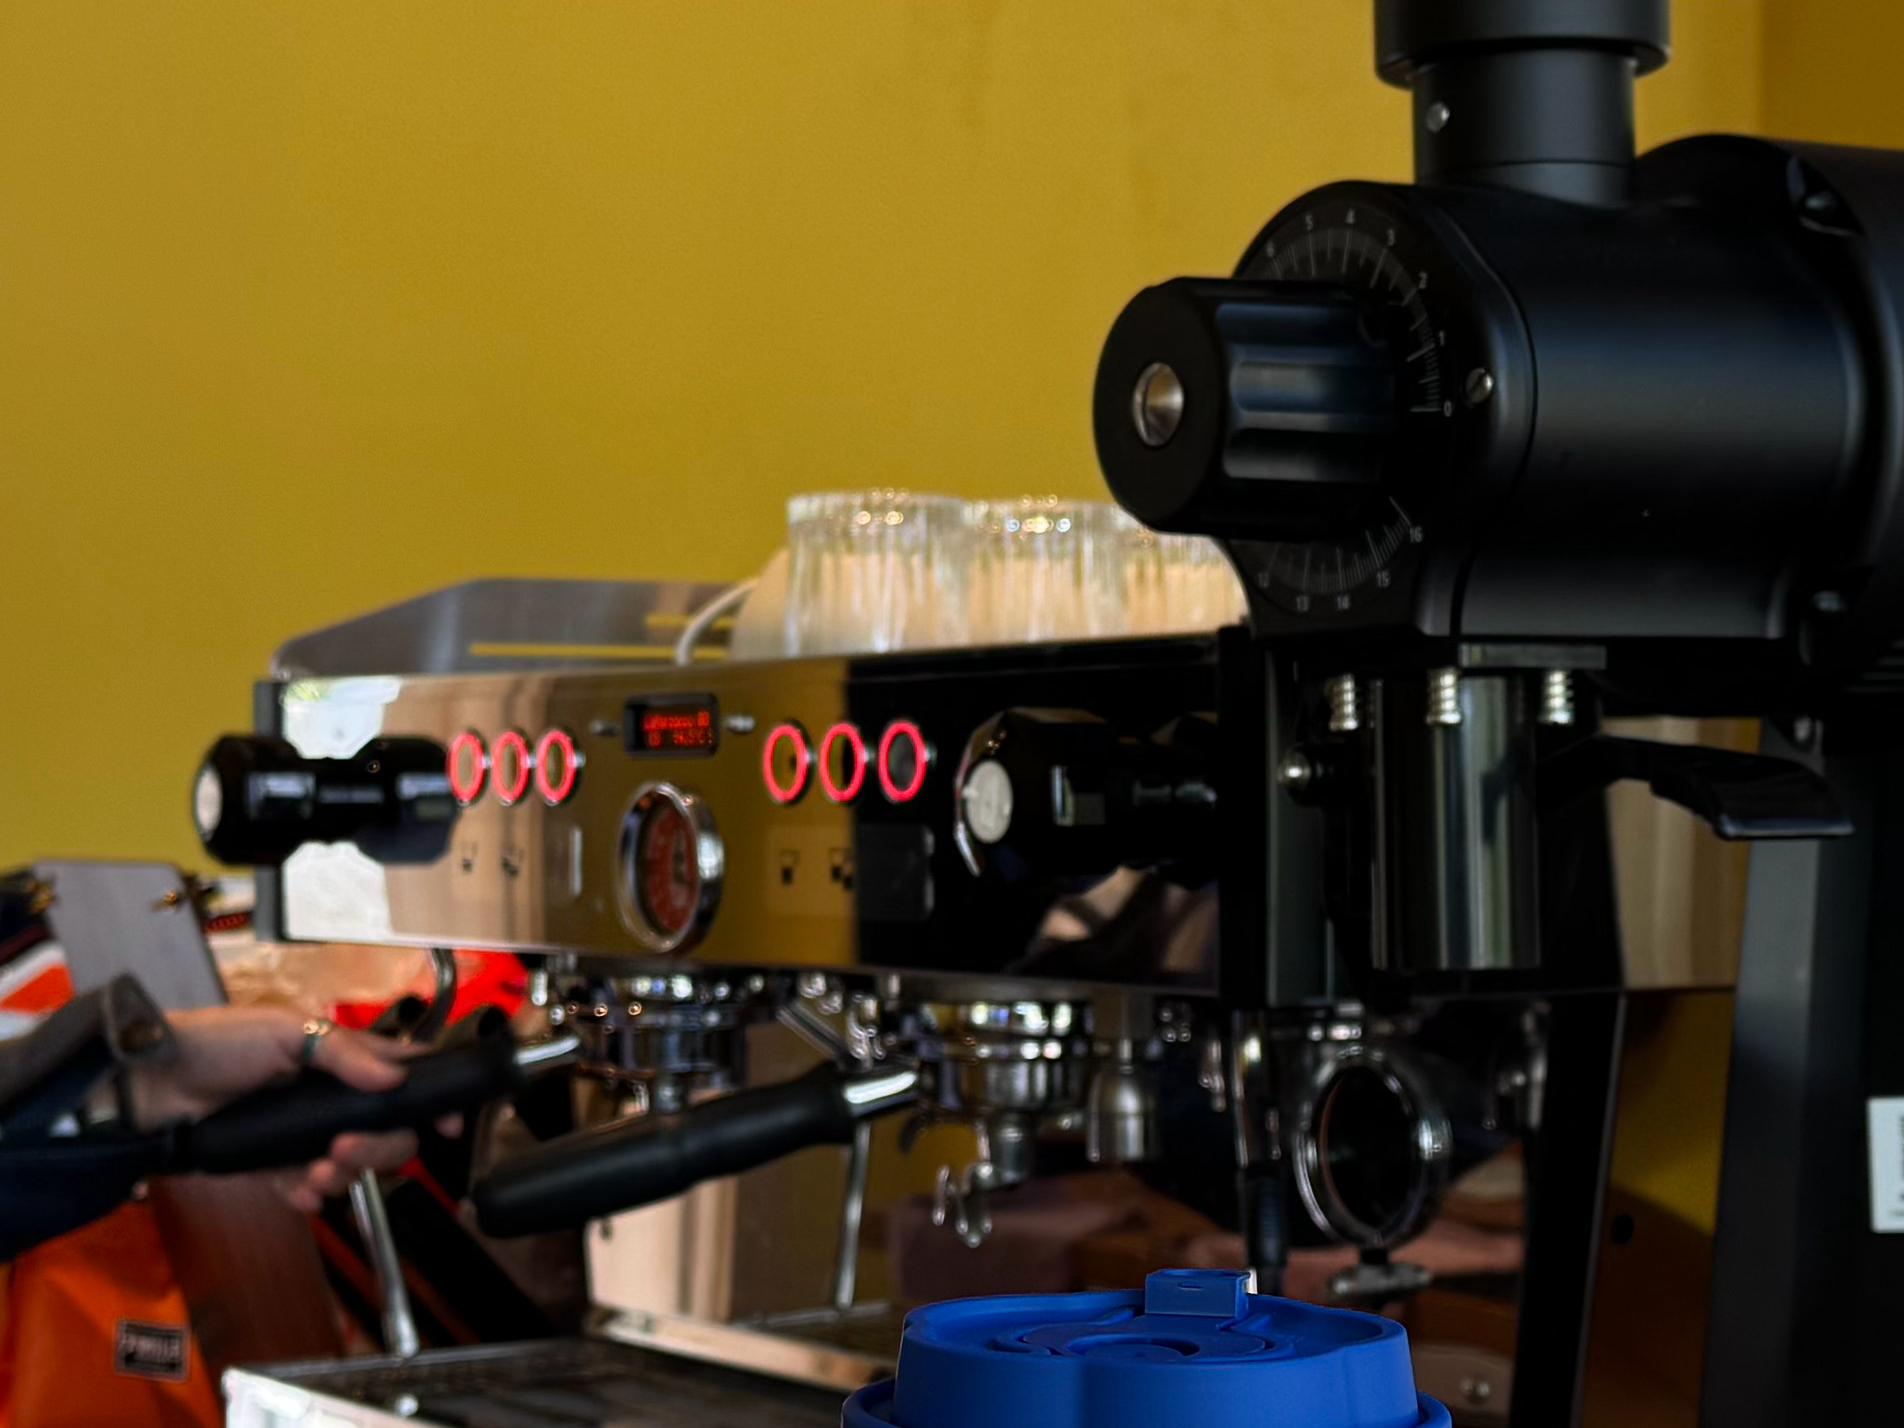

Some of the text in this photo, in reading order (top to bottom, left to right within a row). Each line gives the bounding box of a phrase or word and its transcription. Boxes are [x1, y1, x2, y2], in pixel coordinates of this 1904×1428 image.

[1443, 400, 1453, 417] 0
[1376, 571, 1391, 588] 15
[1409, 526, 1424, 543] 16
